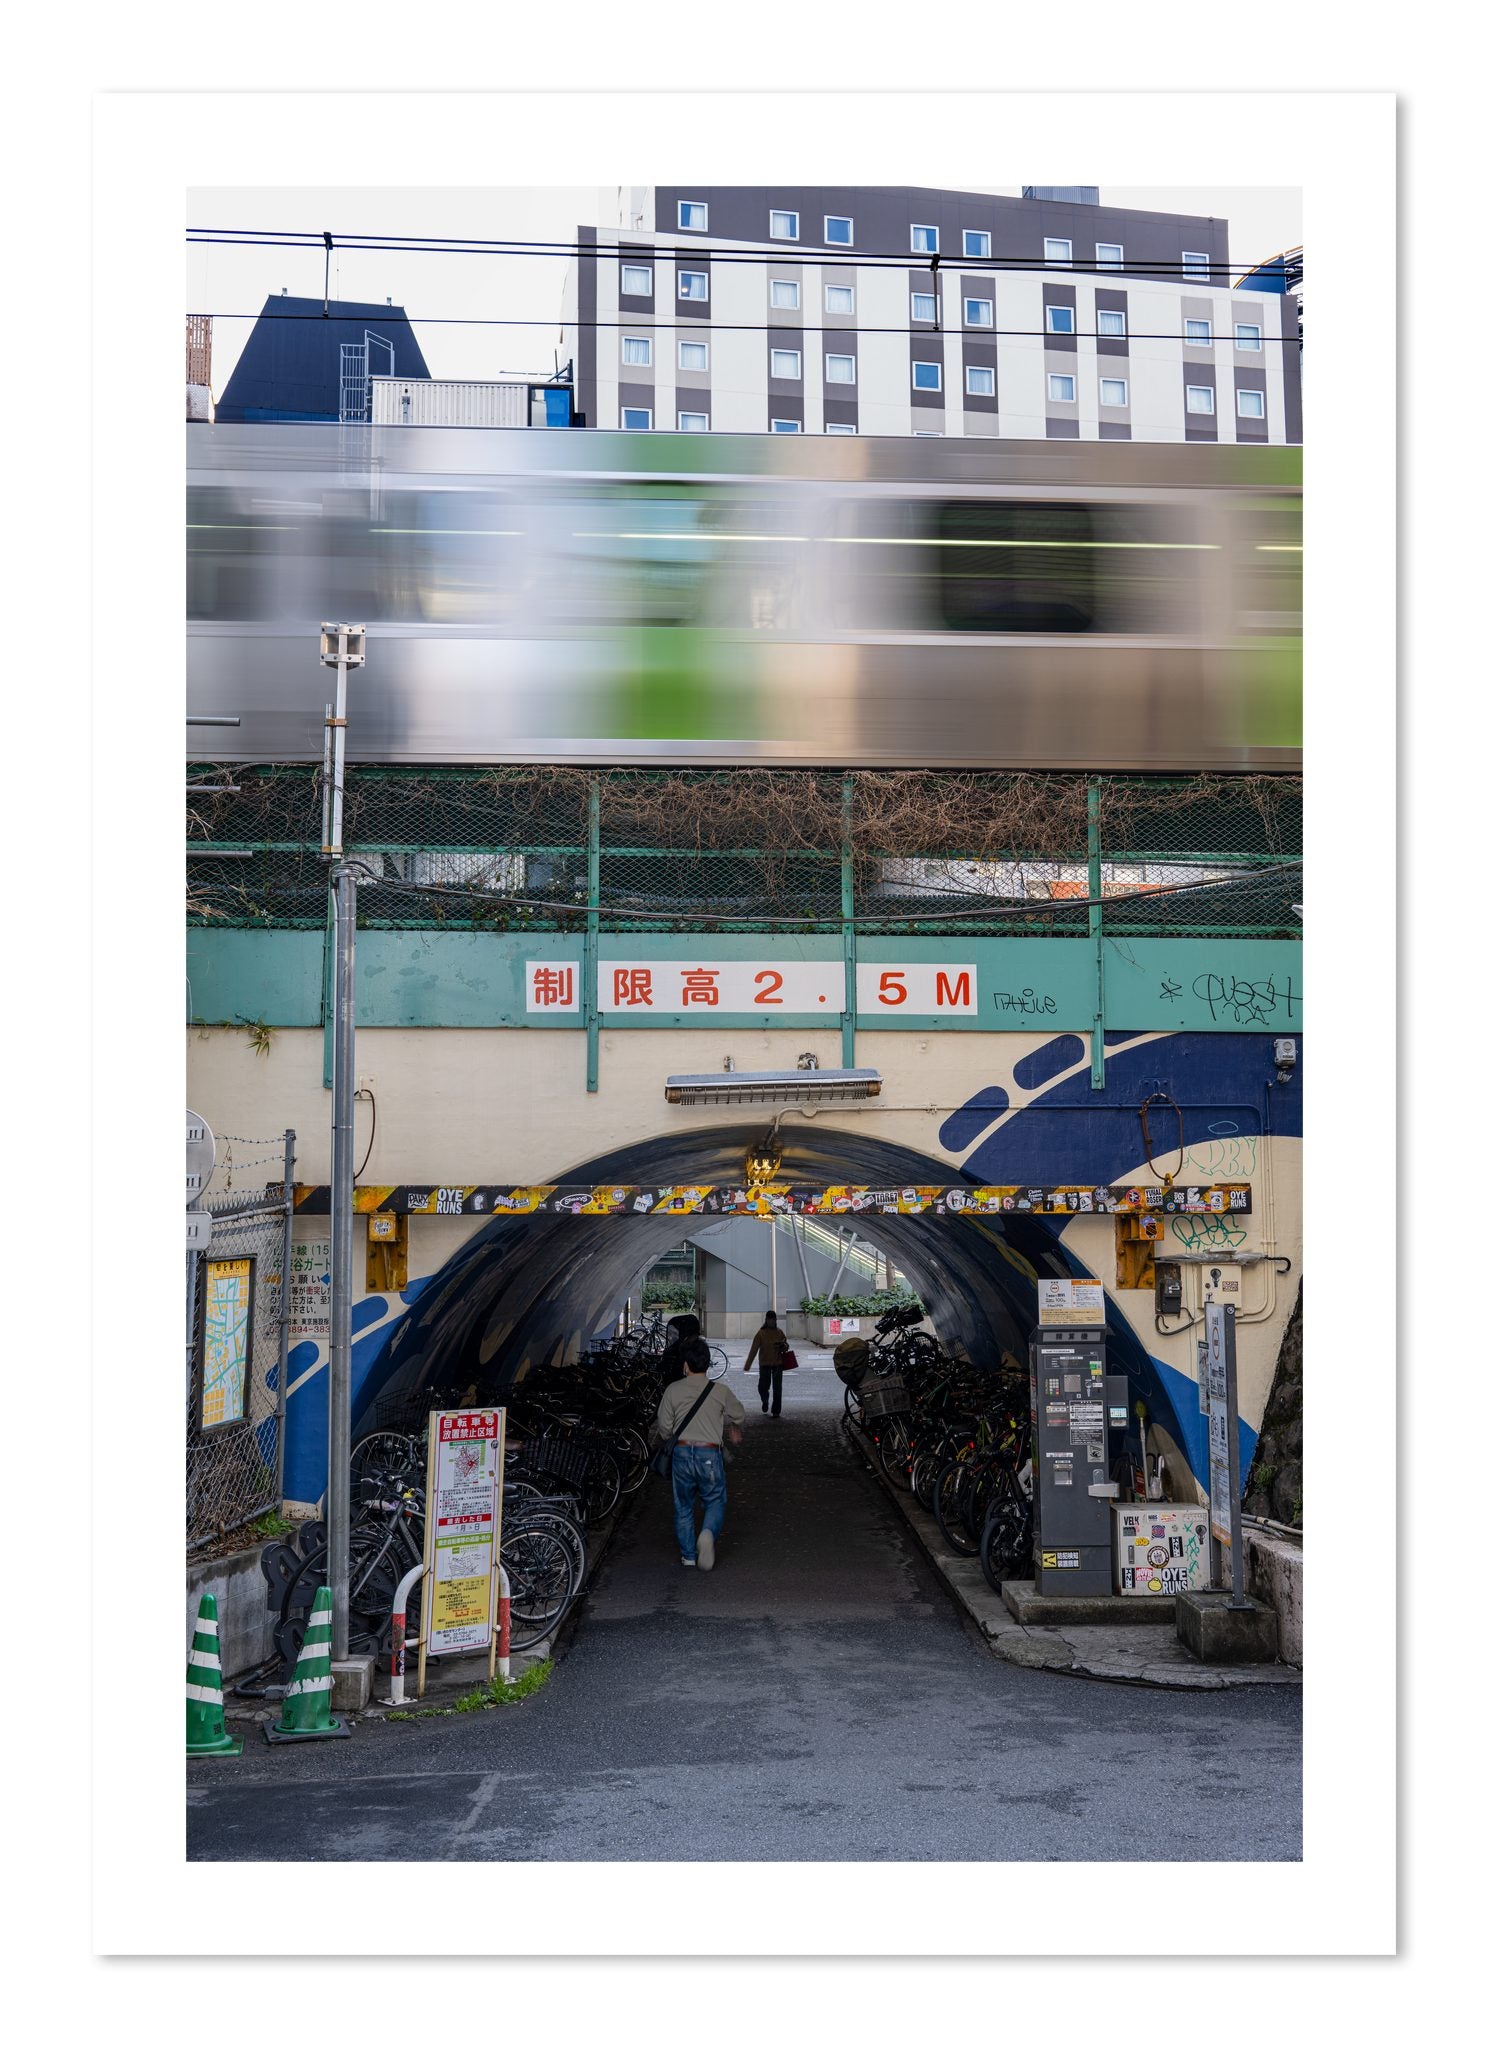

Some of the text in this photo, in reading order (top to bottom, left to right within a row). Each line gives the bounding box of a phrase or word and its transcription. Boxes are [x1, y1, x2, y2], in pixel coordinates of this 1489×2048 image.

[438, 1188, 463, 1201] OYE
[1230, 1191, 1246, 1199] OYE
[436, 1201, 463, 1214] RUNS
[1230, 1199, 1247, 1208] RUNS
[443, 1427, 494, 1439] 放置禁止区域
[1162, 1569, 1187, 1581] OYE
[1162, 1581, 1188, 1595] RUNS
